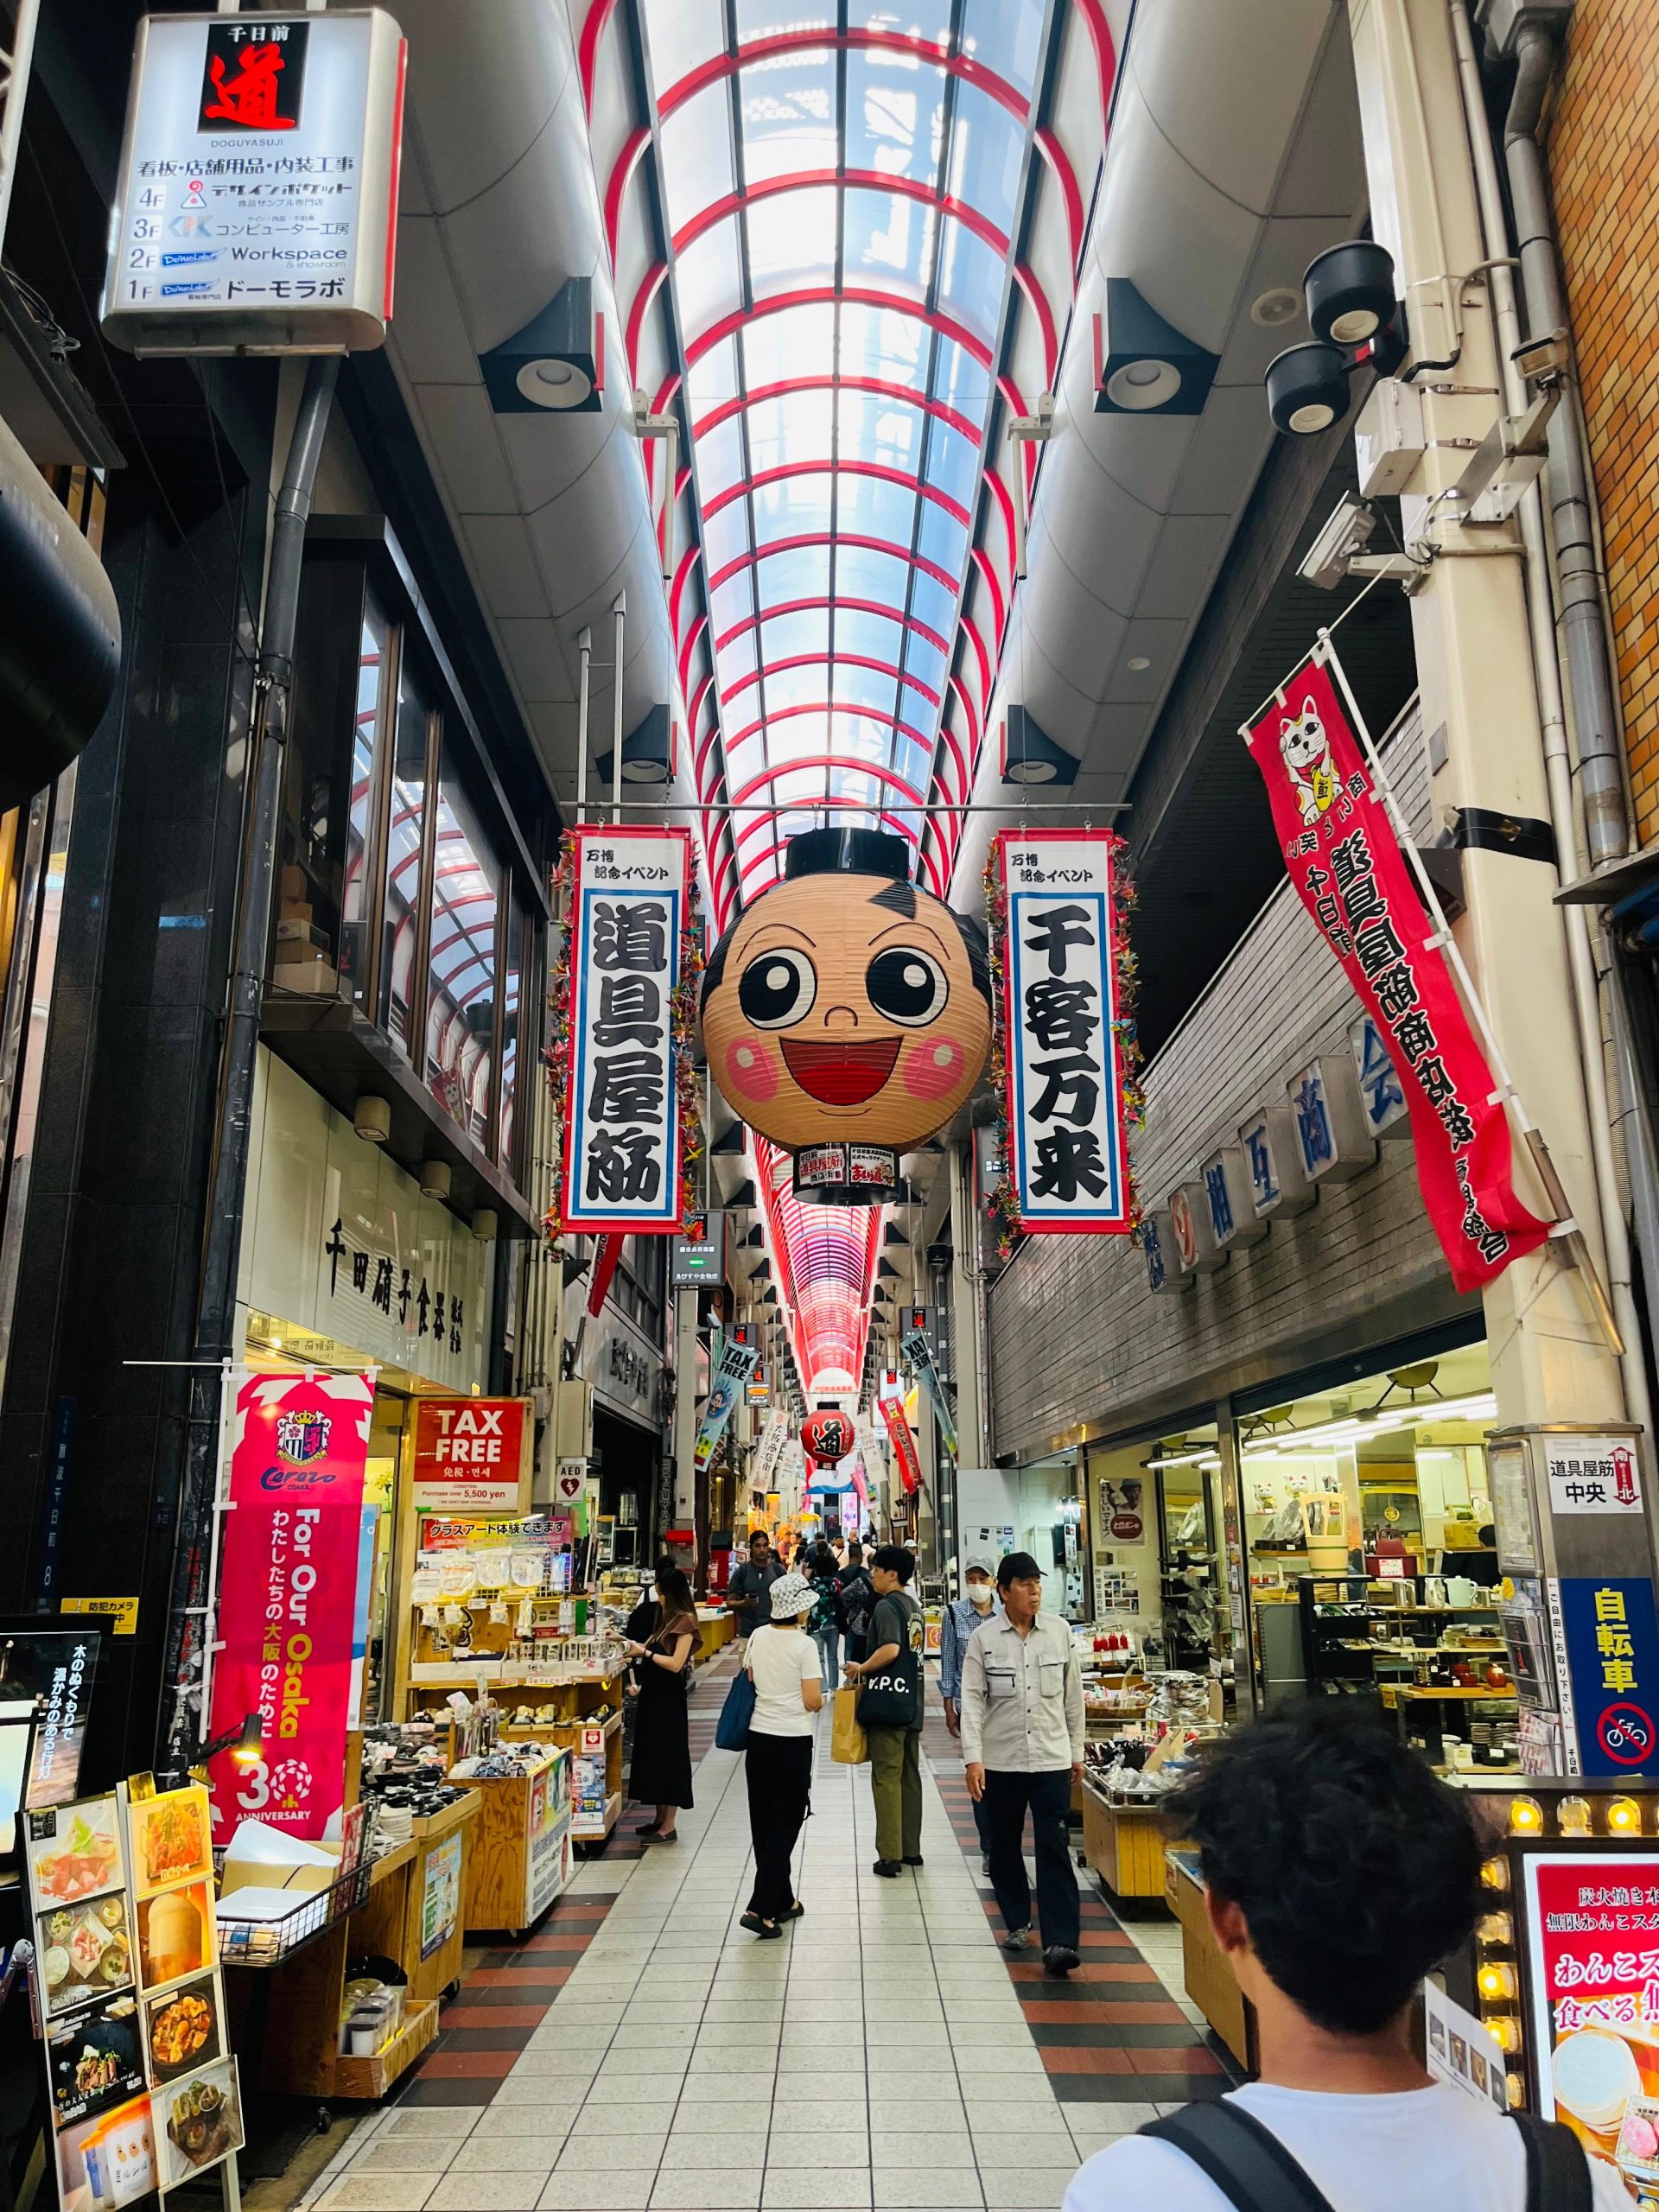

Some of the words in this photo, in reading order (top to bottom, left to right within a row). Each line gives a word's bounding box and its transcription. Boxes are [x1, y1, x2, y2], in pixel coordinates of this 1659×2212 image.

[228, 25, 290, 42] 千日前
[205, 43, 296, 130] 道
[211, 138, 283, 148] DOGUYASUJI
[138, 156, 355, 177] 看板・店舗用品・内装工事
[139, 188, 164, 207] 4F
[211, 182, 353, 197] デザインポケット
[238, 199, 324, 208] 食品サンプル専門店
[133, 219, 161, 238] 3F
[216, 222, 351, 237] コンピューター工房
[130, 250, 156, 269] 2F
[232, 247, 347, 261] Workspace
[128, 280, 153, 300] 1F
[227, 277, 346, 300] ドーモラボ
[587, 850, 614, 863] 万博
[1011, 853, 1039, 867] 万博
[594, 865, 669, 880] 記念イベント
[1020, 869, 1093, 884] 記念イベント
[586, 902, 667, 1203] 道具屋筋
[1024, 904, 1109, 1202] 千客万来
[800, 1155, 844, 1177] 道具屋筋
[725, 1345, 754, 1369] TAX
[720, 1363, 748, 1381] FREE
[438, 1410, 504, 1435] TAX
[435, 1439, 501, 1463] FREE
[560, 1466, 581, 1476] AED
[1550, 1460, 1614, 1477] 道具屋筋
[261, 1466, 336, 1491] Cerezo
[464, 1490, 487, 1498] 5,500
[1566, 1482, 1606, 1503] 中央
[1618, 1488, 1634, 1500] 北
[294, 1508, 321, 1558] For
[430, 1520, 566, 1536] グラスアート体験できます
[289, 1565, 317, 1625] Our
[89, 1602, 134, 1611] 防犯カメラ
[260, 1510, 289, 1739] わたしたちの大阪のために
[1594, 1586, 1638, 1693] 自転車
[1550, 1593, 1572, 1713] ご自由にお取り下さい
[61, 1644, 87, 1741] 木のぬくもりで
[279, 1633, 313, 1739] Osaka
[235, 1810, 311, 1822] ANNIVERSARY
[1579, 1887, 1659, 1906] 炭火焼き本
[1547, 1913, 1659, 1931] 無限わんこスタ
[1555, 1949, 1659, 1986] わんこス
